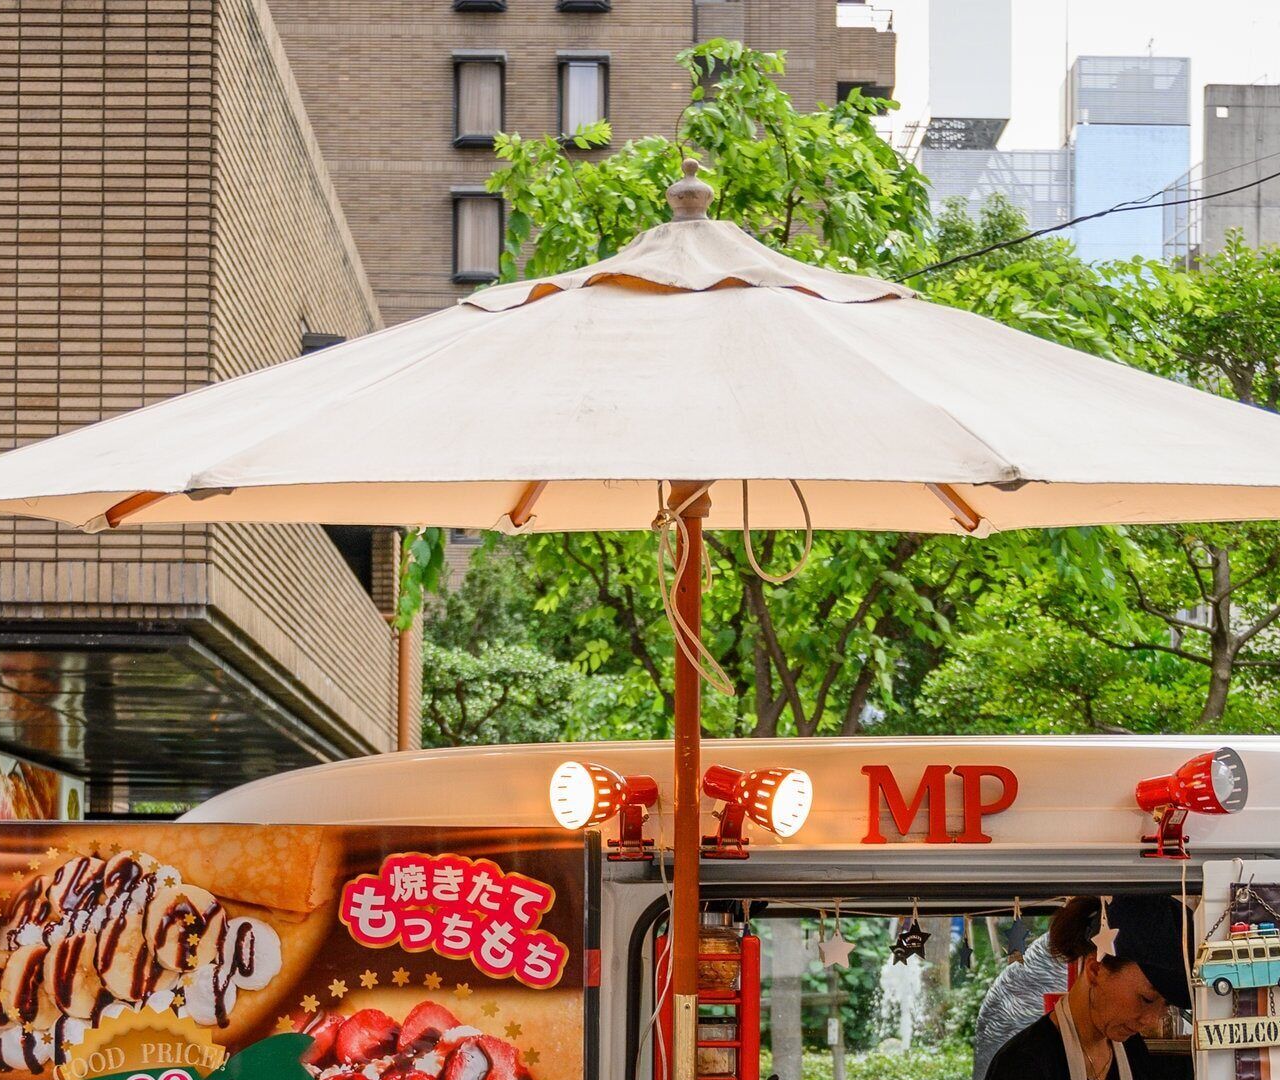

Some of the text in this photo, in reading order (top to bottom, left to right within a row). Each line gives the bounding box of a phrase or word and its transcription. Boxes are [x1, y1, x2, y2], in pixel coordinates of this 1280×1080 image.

[860, 764, 1019, 844] MP
[348, 886, 561, 980] もっちもち
[389, 863, 546, 925] 焼きたて
